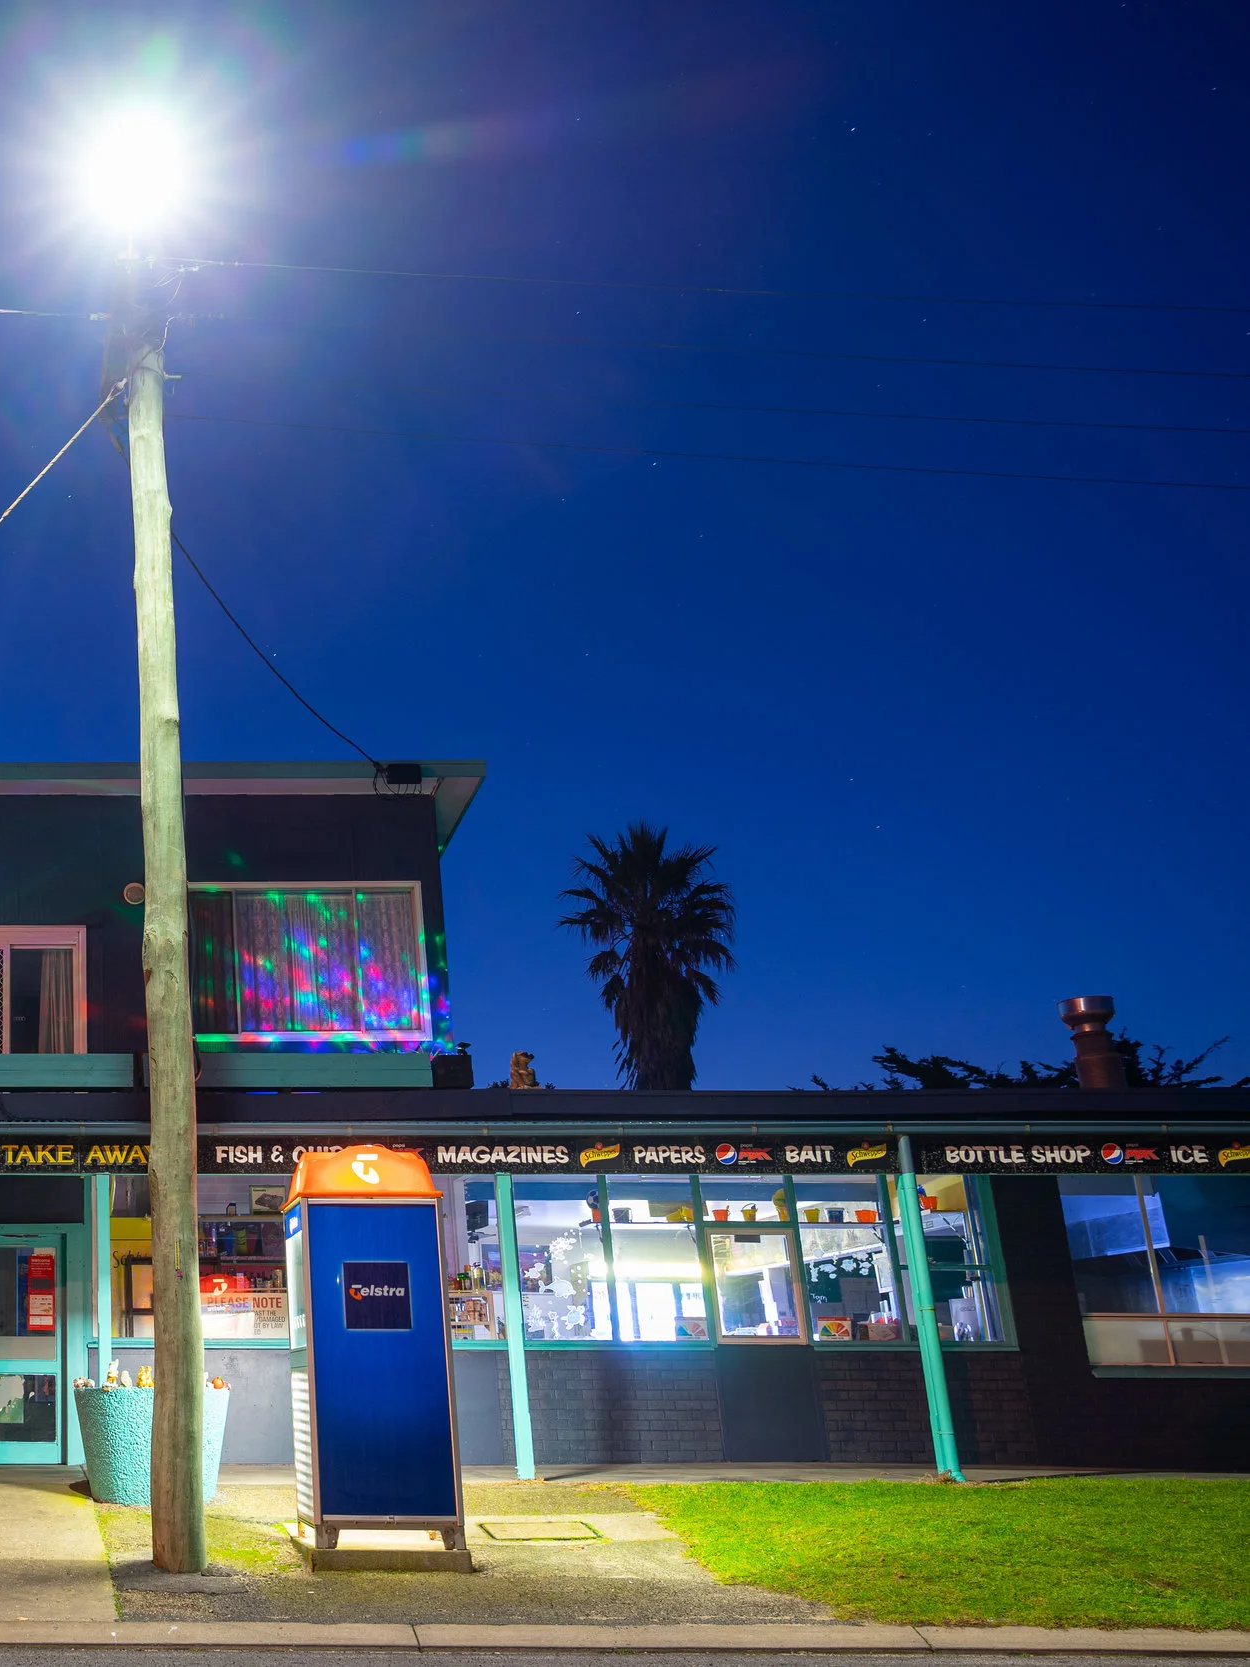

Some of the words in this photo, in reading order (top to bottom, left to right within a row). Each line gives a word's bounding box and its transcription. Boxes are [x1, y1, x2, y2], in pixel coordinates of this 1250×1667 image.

[2, 1144, 75, 1165] TAKE
[86, 1144, 150, 1165] AWA
[215, 1145, 263, 1164] FISH
[270, 1145, 284, 1164] &
[437, 1145, 569, 1164] MAGAZINES
[633, 1145, 706, 1165] PAPERS
[784, 1144, 835, 1163] BAIT
[945, 1145, 1027, 1164] BOTTLE
[1031, 1145, 1092, 1164] SHOP
[1170, 1145, 1209, 1164] ICE
[349, 1284, 406, 1300] Telstra
[206, 1297, 250, 1309] PLEASE
[253, 1297, 283, 1308] NOTE
